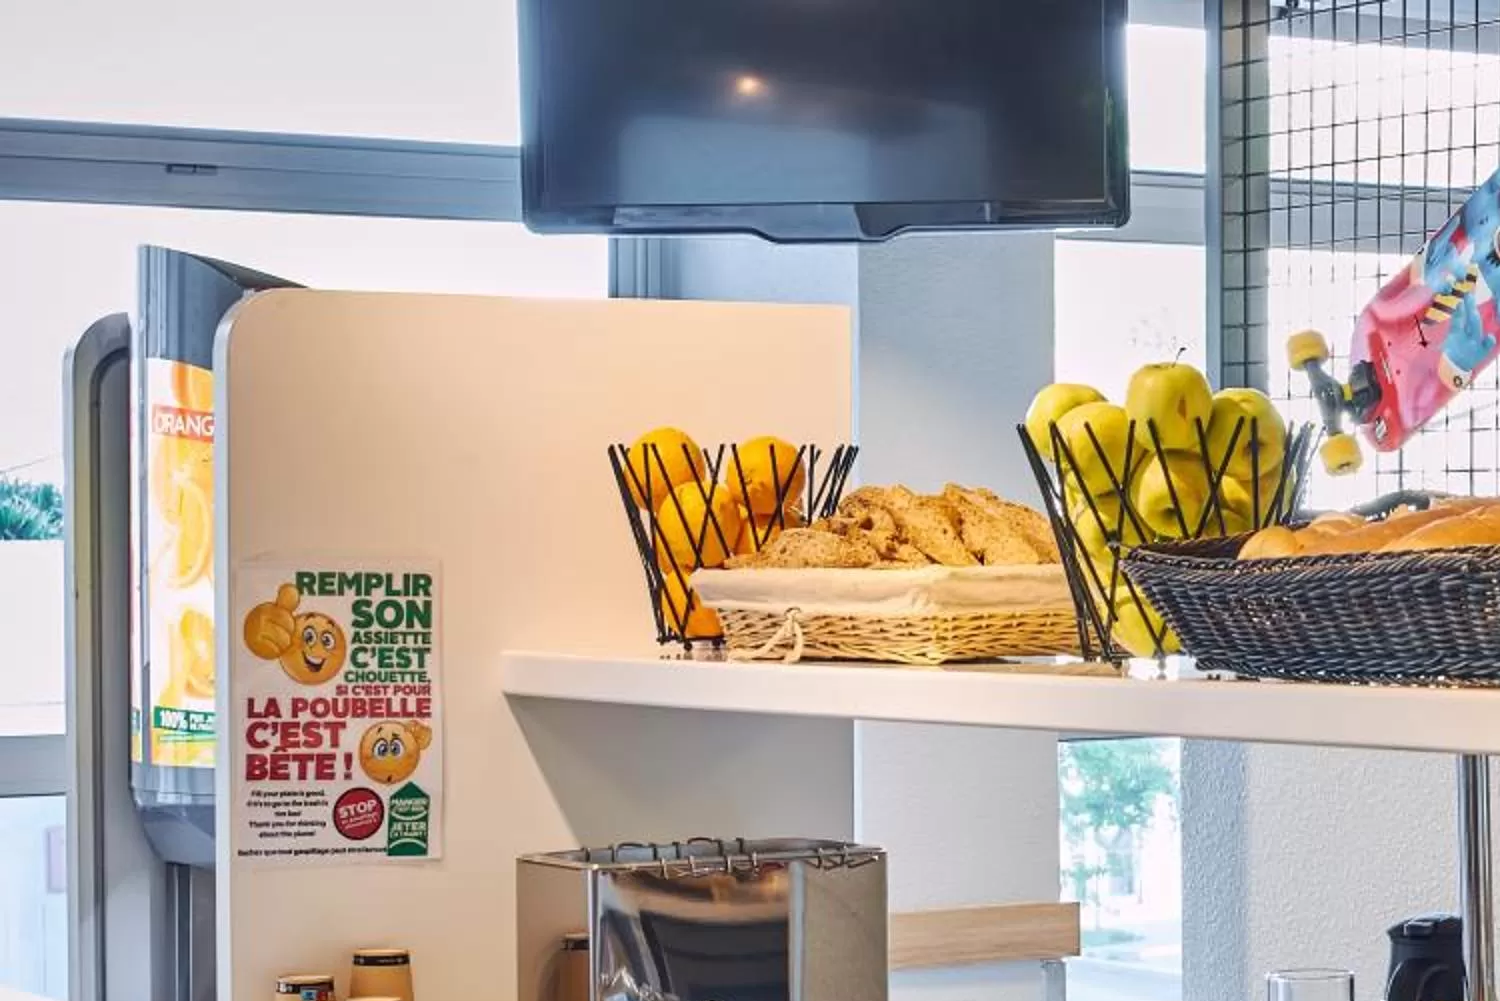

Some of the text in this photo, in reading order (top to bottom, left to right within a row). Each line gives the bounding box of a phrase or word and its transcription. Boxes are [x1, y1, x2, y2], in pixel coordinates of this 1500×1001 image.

[152, 411, 216, 437] ORANG
[296, 571, 433, 597] REMPLIR
[351, 598, 432, 629] SON
[351, 631, 432, 645] ASSIETTE
[350, 645, 432, 669] C'EST
[335, 683, 431, 697] SI C'EST POUR
[246, 696, 433, 719] LA POUBELLE
[159, 708, 191, 731] 100%
[245, 720, 347, 749] C'EST
[245, 745, 354, 781] BÊTE !
[338, 798, 377, 817] STOP
[391, 821, 427, 834] JETER
